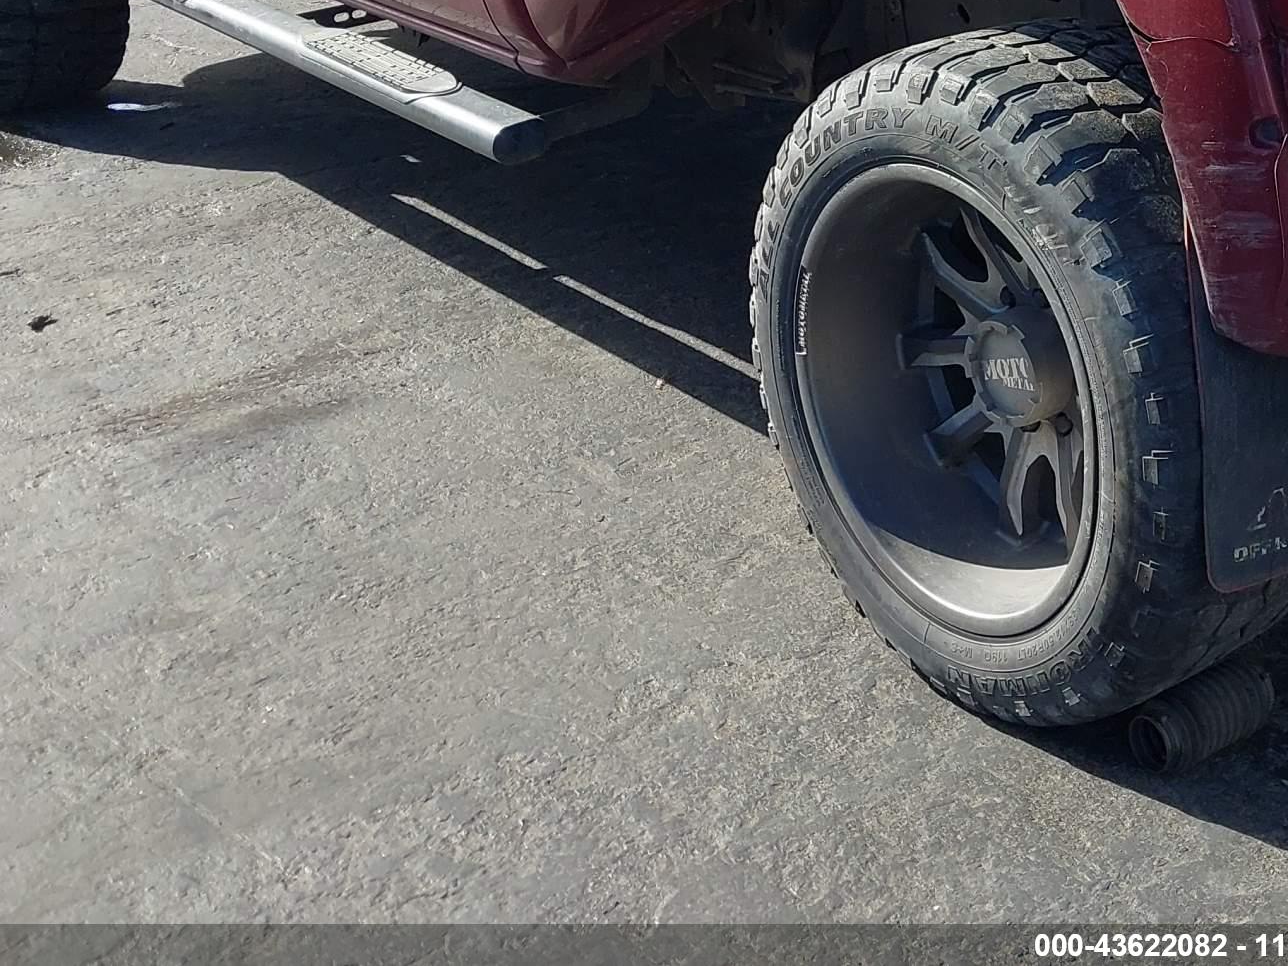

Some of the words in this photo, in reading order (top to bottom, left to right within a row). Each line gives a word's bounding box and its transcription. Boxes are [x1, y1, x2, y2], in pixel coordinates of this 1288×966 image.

[779, 108, 915, 209] COUNTRY
[925, 114, 1008, 171] M/T
[948, 626, 1101, 697] IRONMAN
